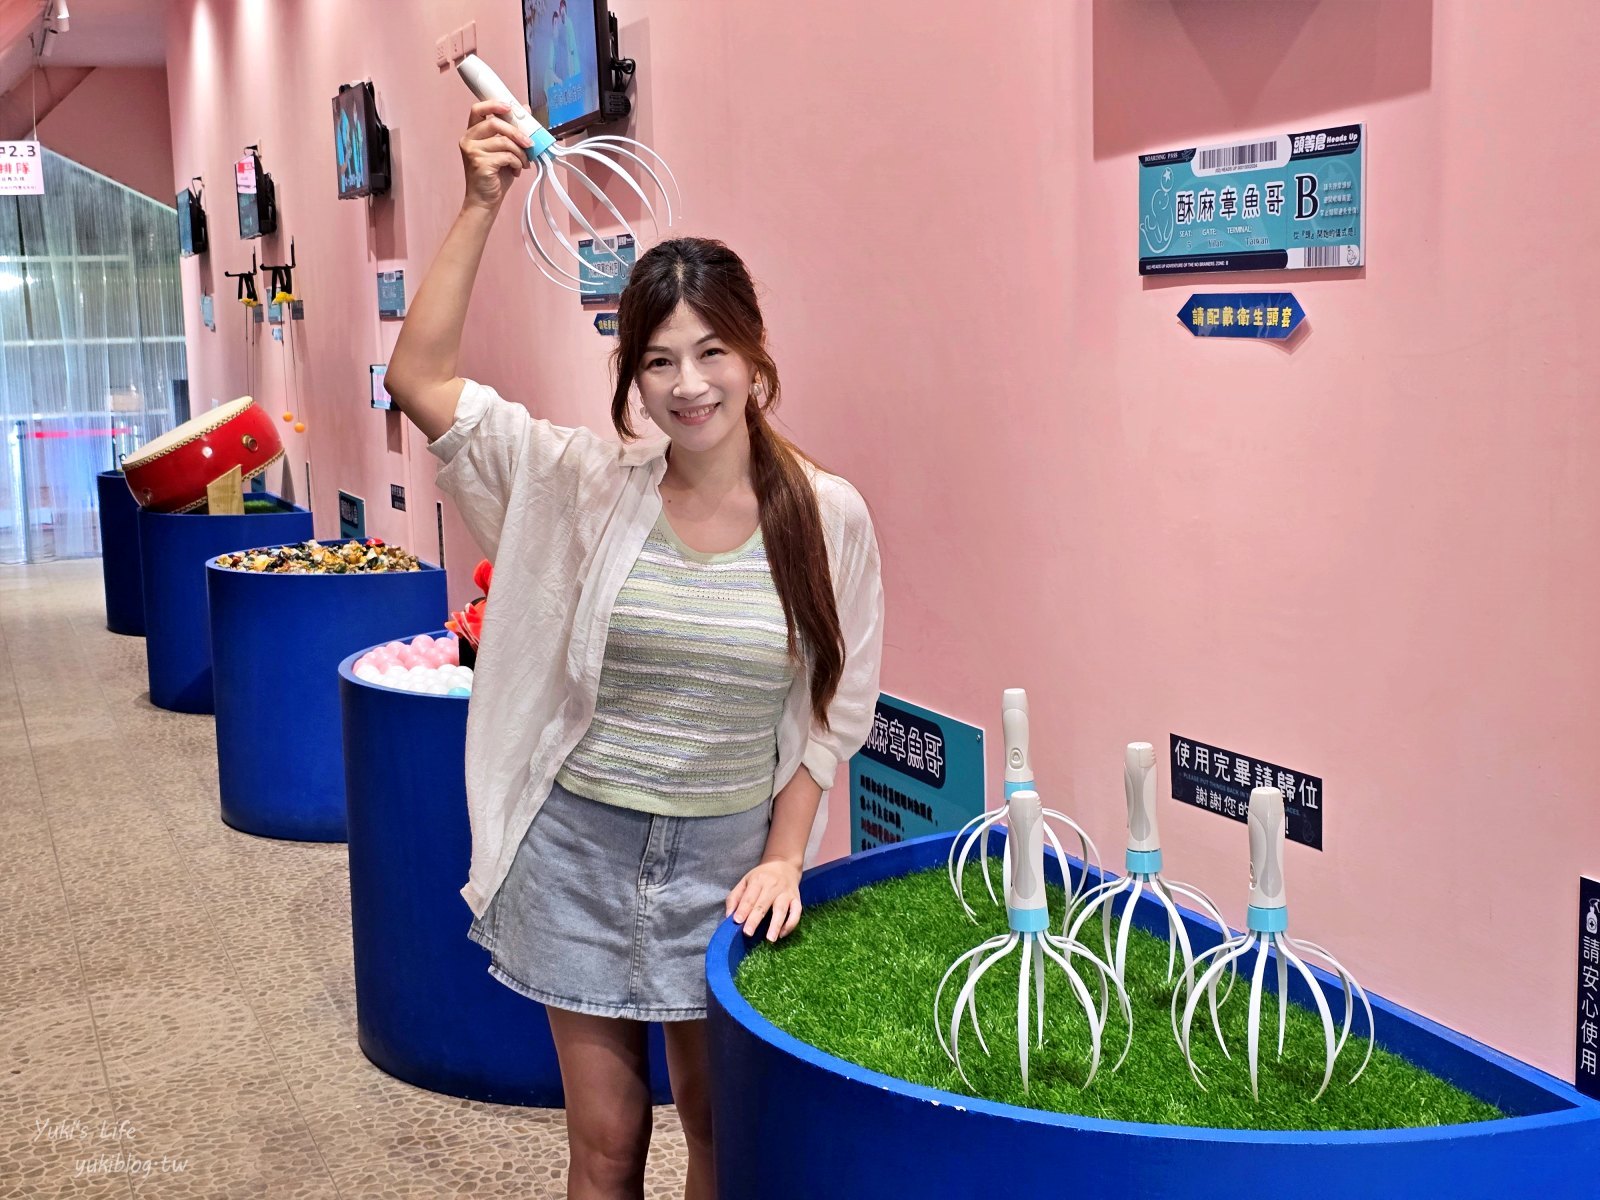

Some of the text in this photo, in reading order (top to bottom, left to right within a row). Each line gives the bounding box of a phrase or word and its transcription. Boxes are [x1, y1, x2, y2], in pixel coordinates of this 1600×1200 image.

[1293, 133, 1327, 154] 頭等倉
[1326, 134, 1347, 144] Heads
[1348, 132, 1358, 142] Up
[1177, 183, 1284, 223] 酥麻章魚哥
[1294, 173, 1320, 220] B
[1245, 237, 1269, 247] Taiwan
[1175, 739, 1319, 810] 使用完畢請歸位
[1580, 936, 1600, 1075] 請安心使用
